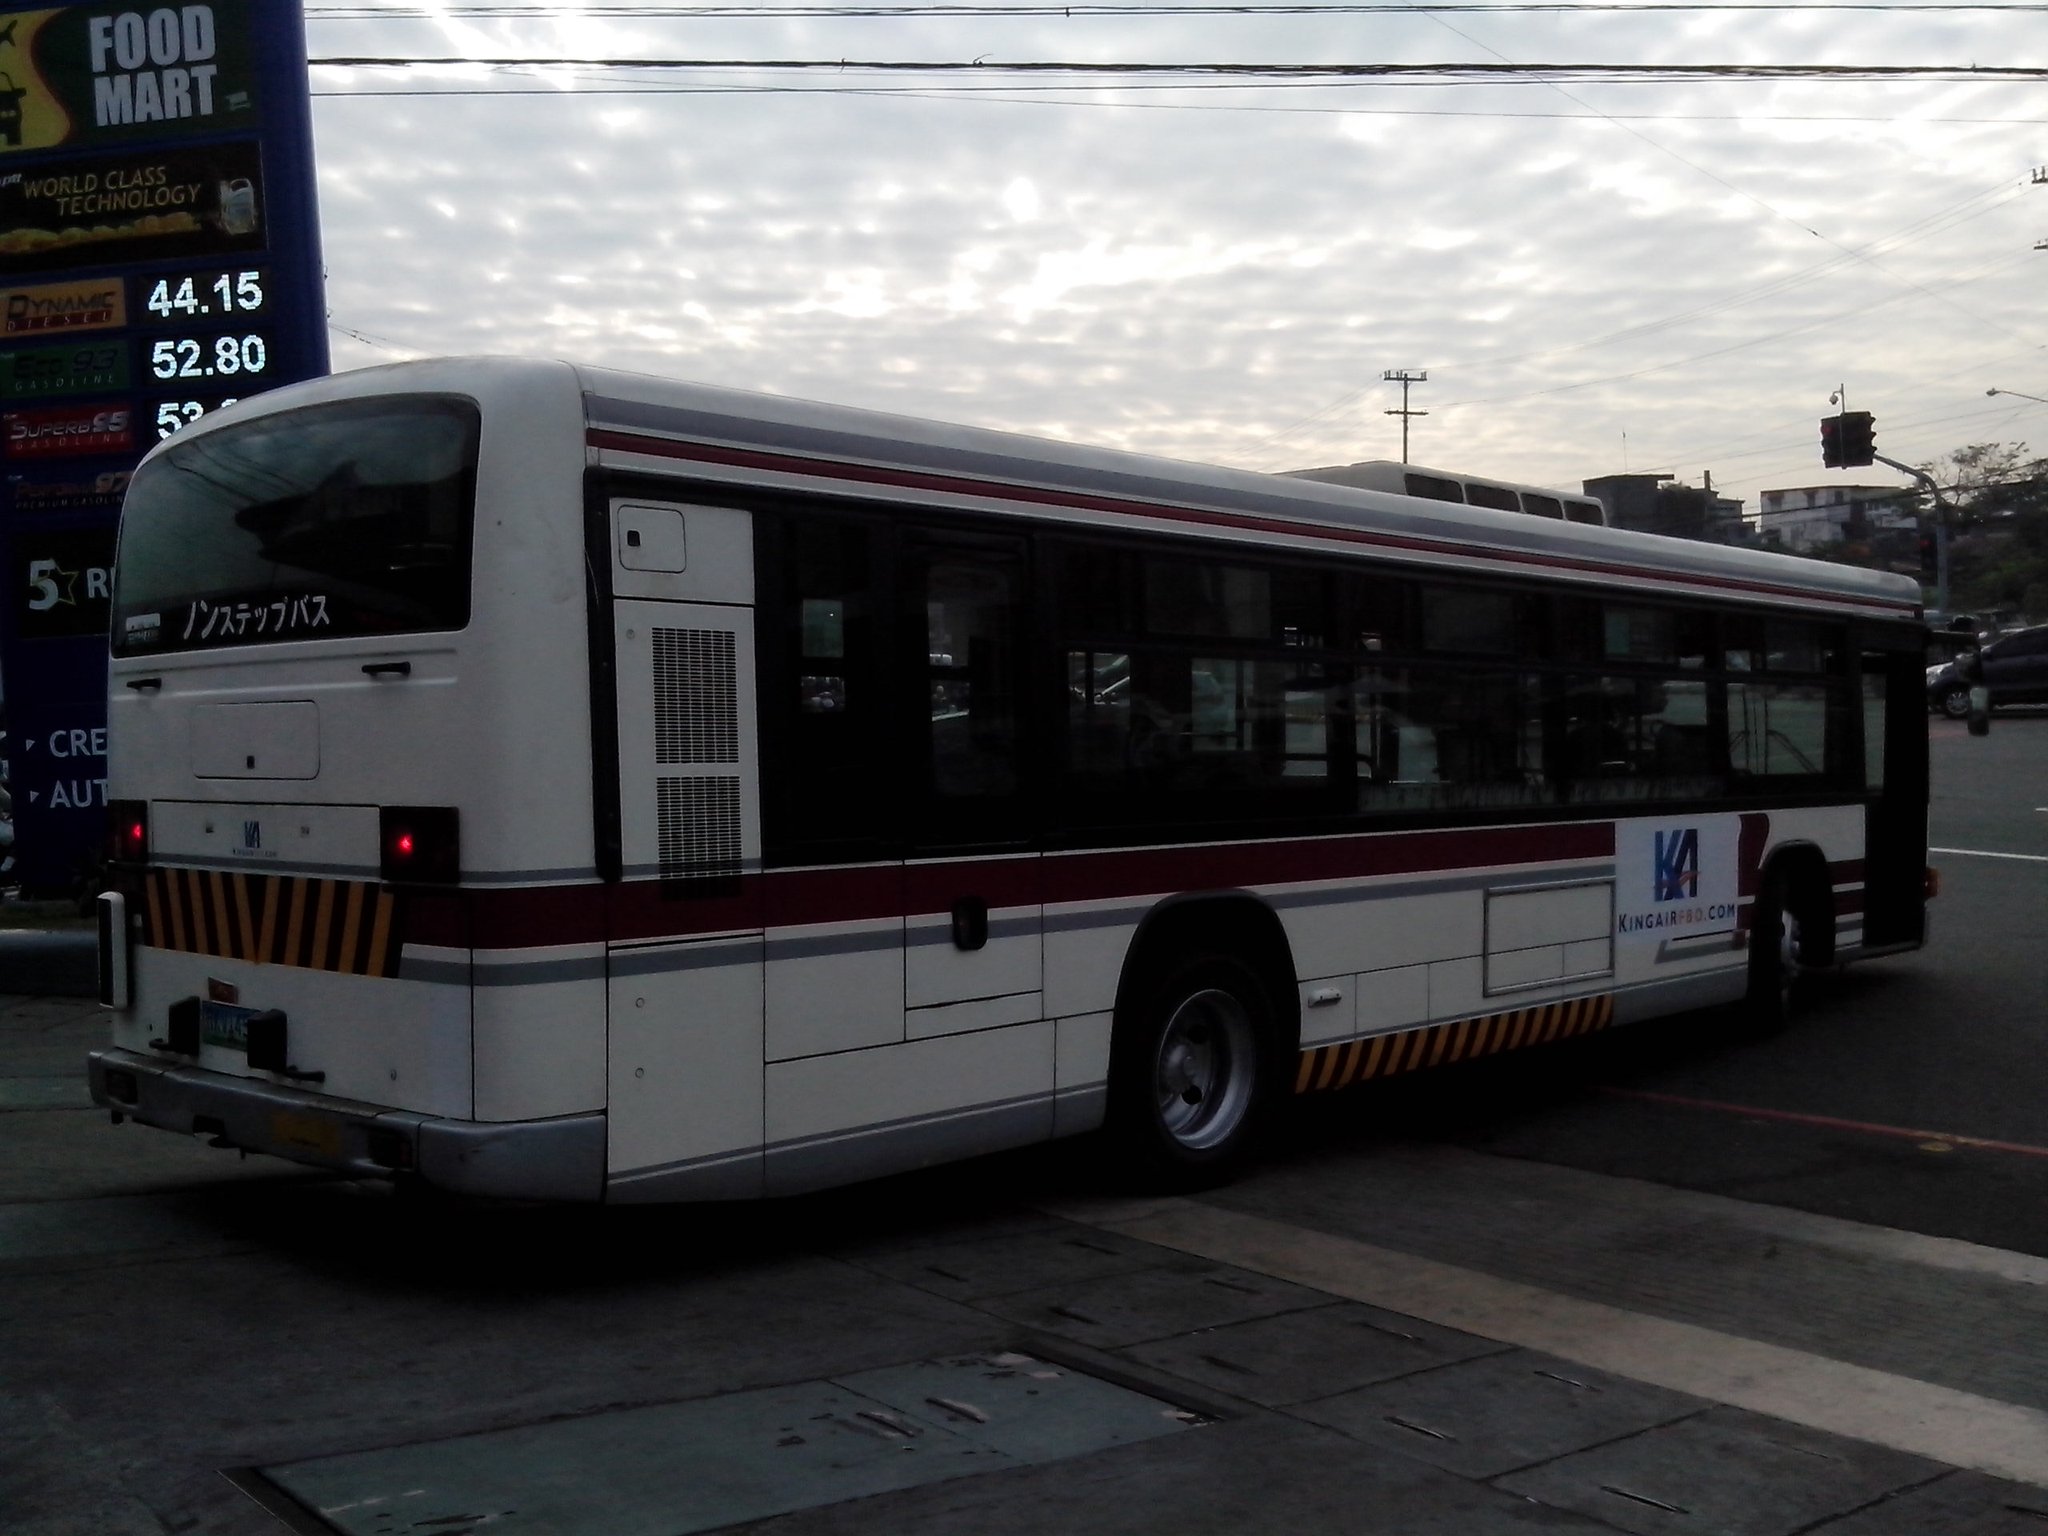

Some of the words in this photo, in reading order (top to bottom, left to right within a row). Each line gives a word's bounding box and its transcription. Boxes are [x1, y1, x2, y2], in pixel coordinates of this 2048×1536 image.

[88, 5, 216, 73] FOOD
[94, 64, 218, 127] MART
[24, 173, 97, 200] WORLD
[104, 166, 167, 192] CLASS
[57, 184, 201, 216] TECHNOLOGY
[148, 270, 264, 318] 44.15
[152, 334, 267, 380] 52.80
[71, 494, 124, 507] GASOLIN
[183, 595, 330, 640] ノンステップバス
[1654, 828, 1698, 902] KA
